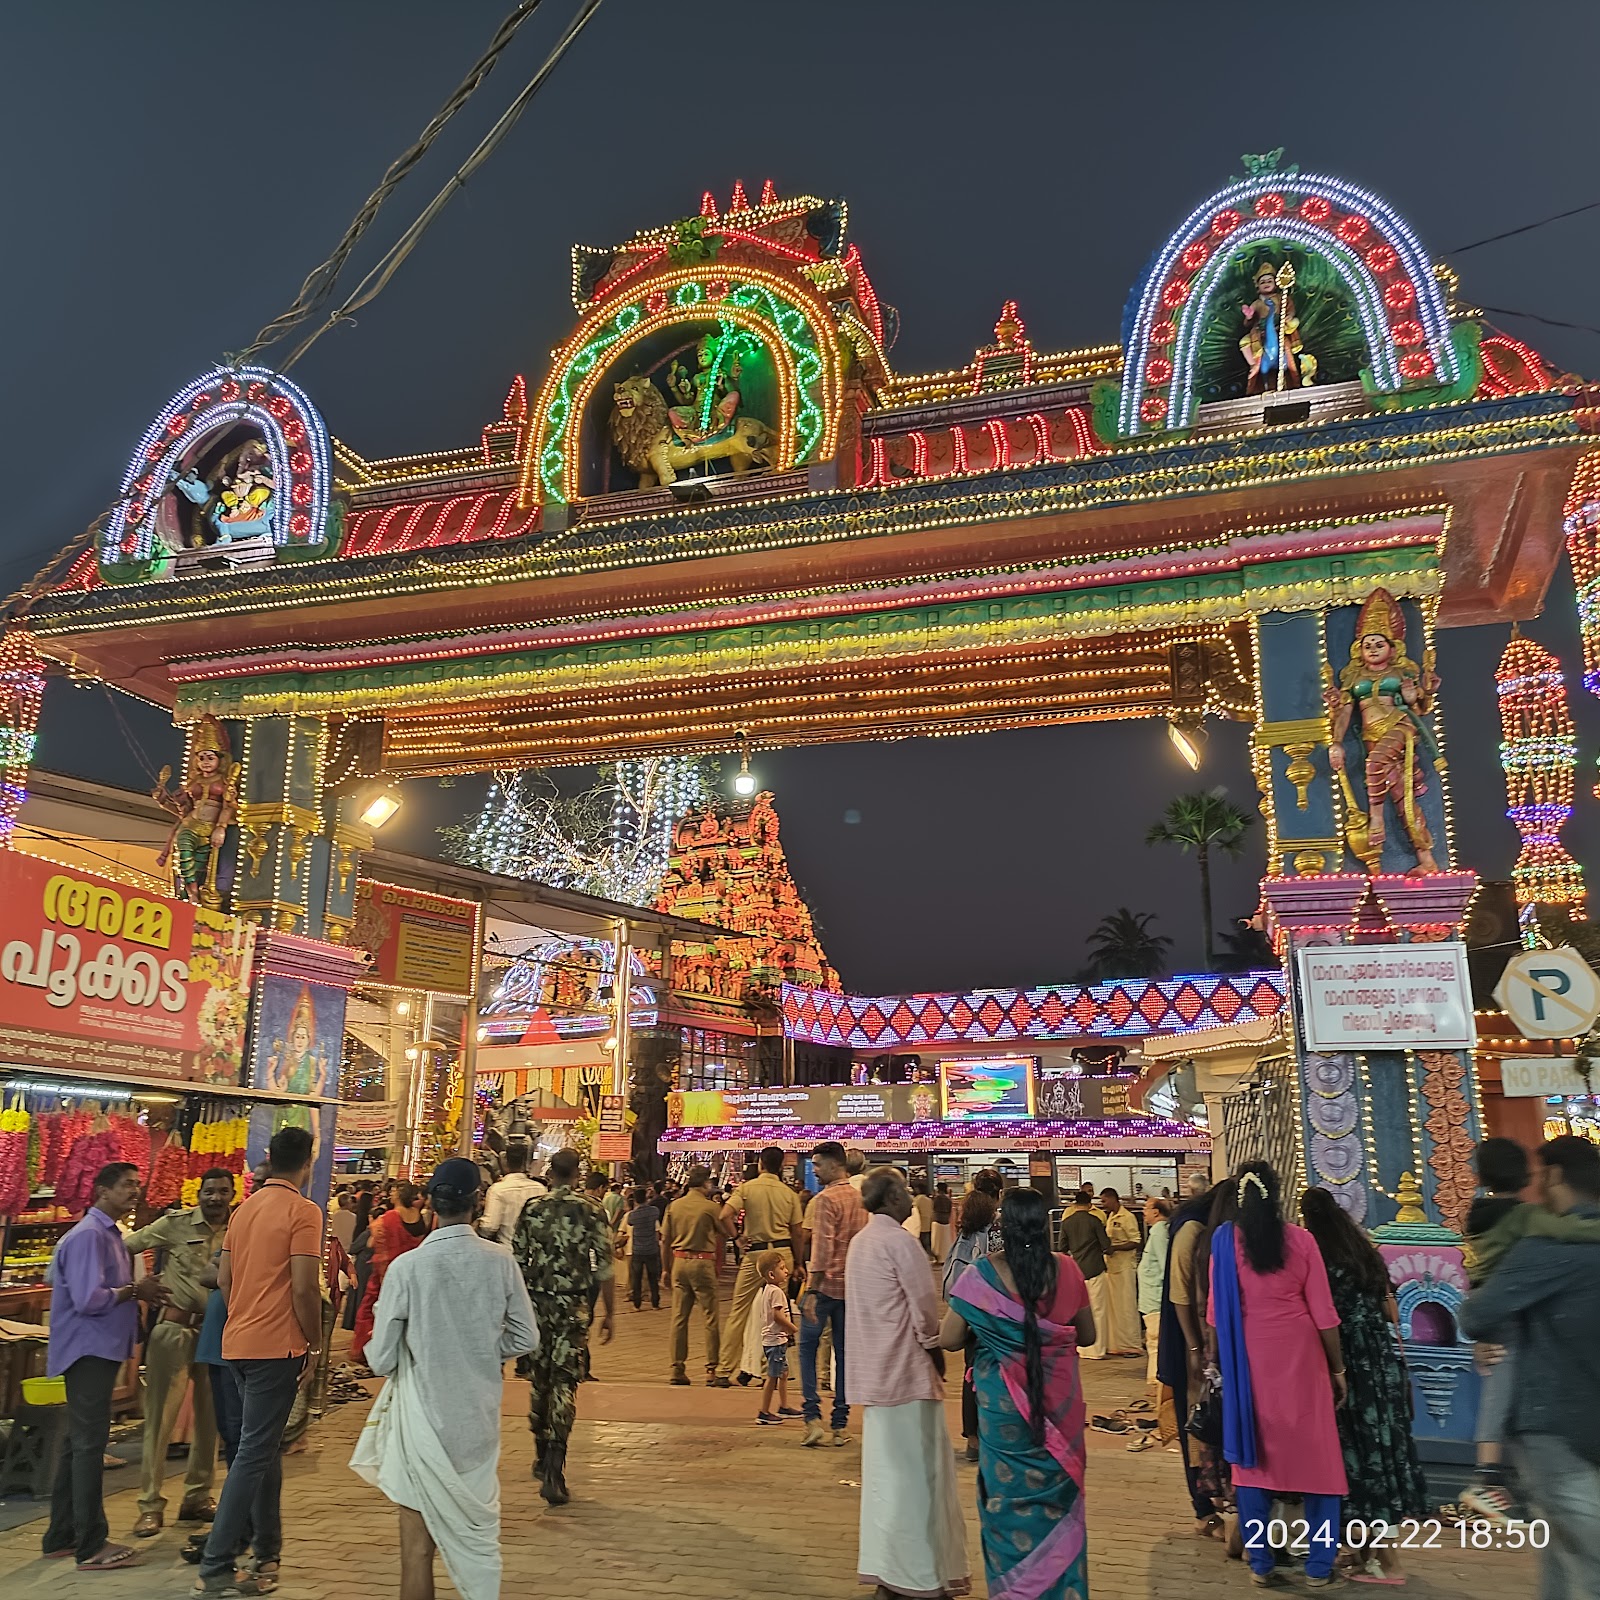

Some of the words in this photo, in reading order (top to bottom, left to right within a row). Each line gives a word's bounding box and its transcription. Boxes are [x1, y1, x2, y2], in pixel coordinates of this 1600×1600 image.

[43, 874, 173, 949] അമ്മ
[382, 890, 472, 919] പൊങ്കാല
[1, 929, 189, 1012] പൂക്കട
[1324, 988, 1396, 1009] വാഹനങ്ങളുടെ
[1529, 969, 1571, 1020] P
[1507, 1066, 1531, 1087] NO
